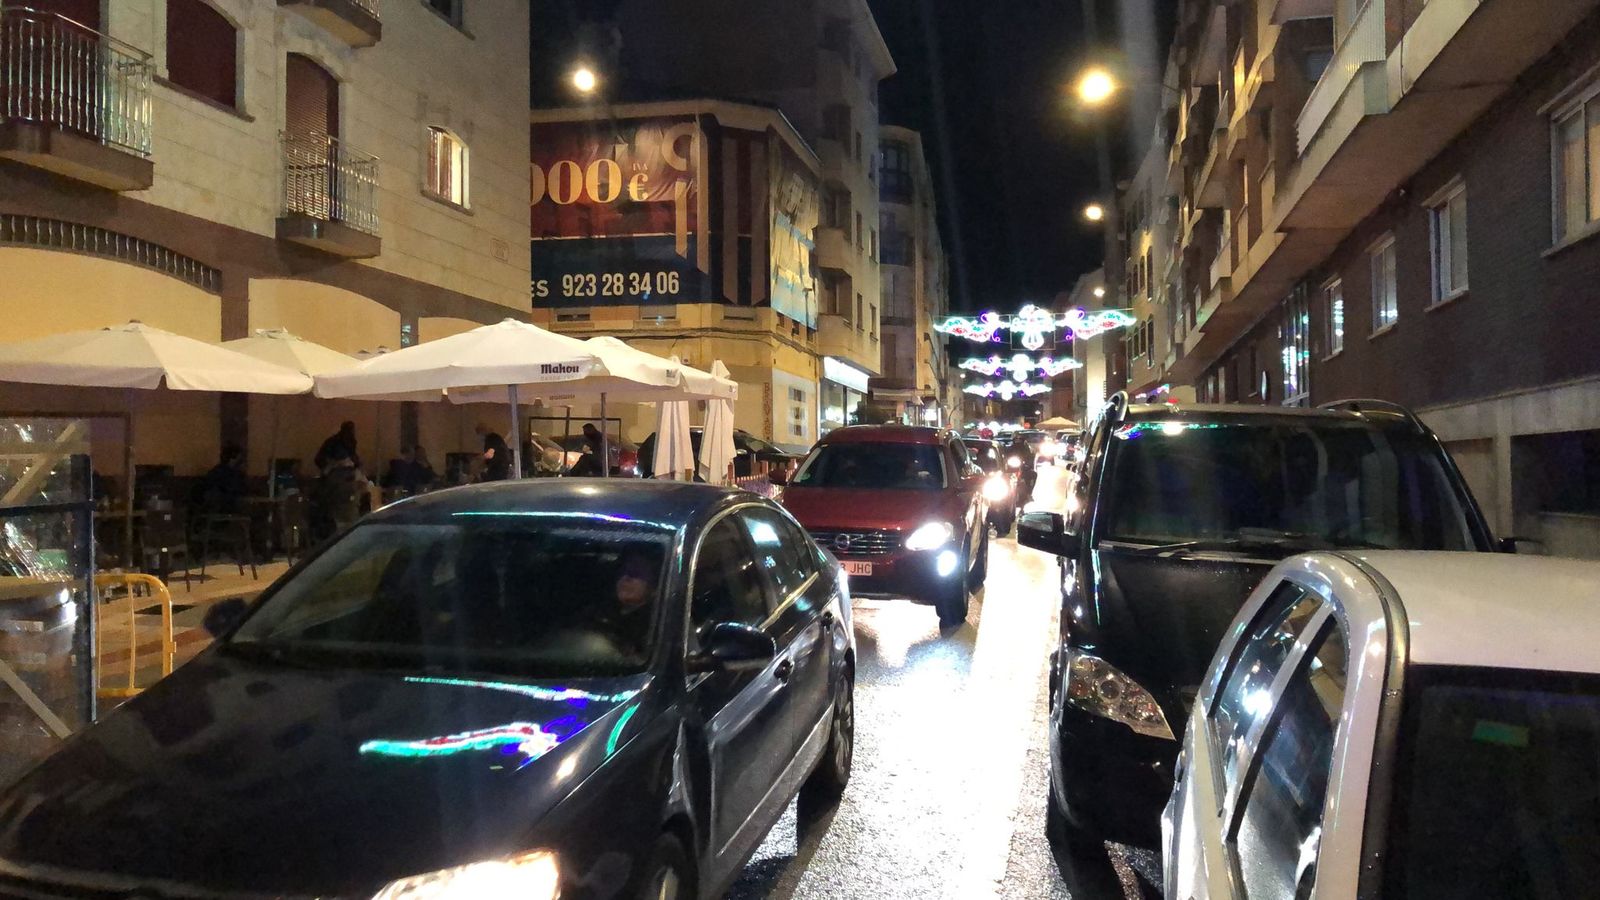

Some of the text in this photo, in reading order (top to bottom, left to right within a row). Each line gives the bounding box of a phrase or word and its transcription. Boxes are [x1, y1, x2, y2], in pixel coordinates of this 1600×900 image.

[632, 162, 648, 171] IVA
[627, 173, 649, 201] €
[562, 273, 597, 297] 923
[602, 273, 624, 296] 28
[629, 272, 651, 296] 34
[656, 271, 680, 295] 06
[541, 363, 579, 374] Mahou
